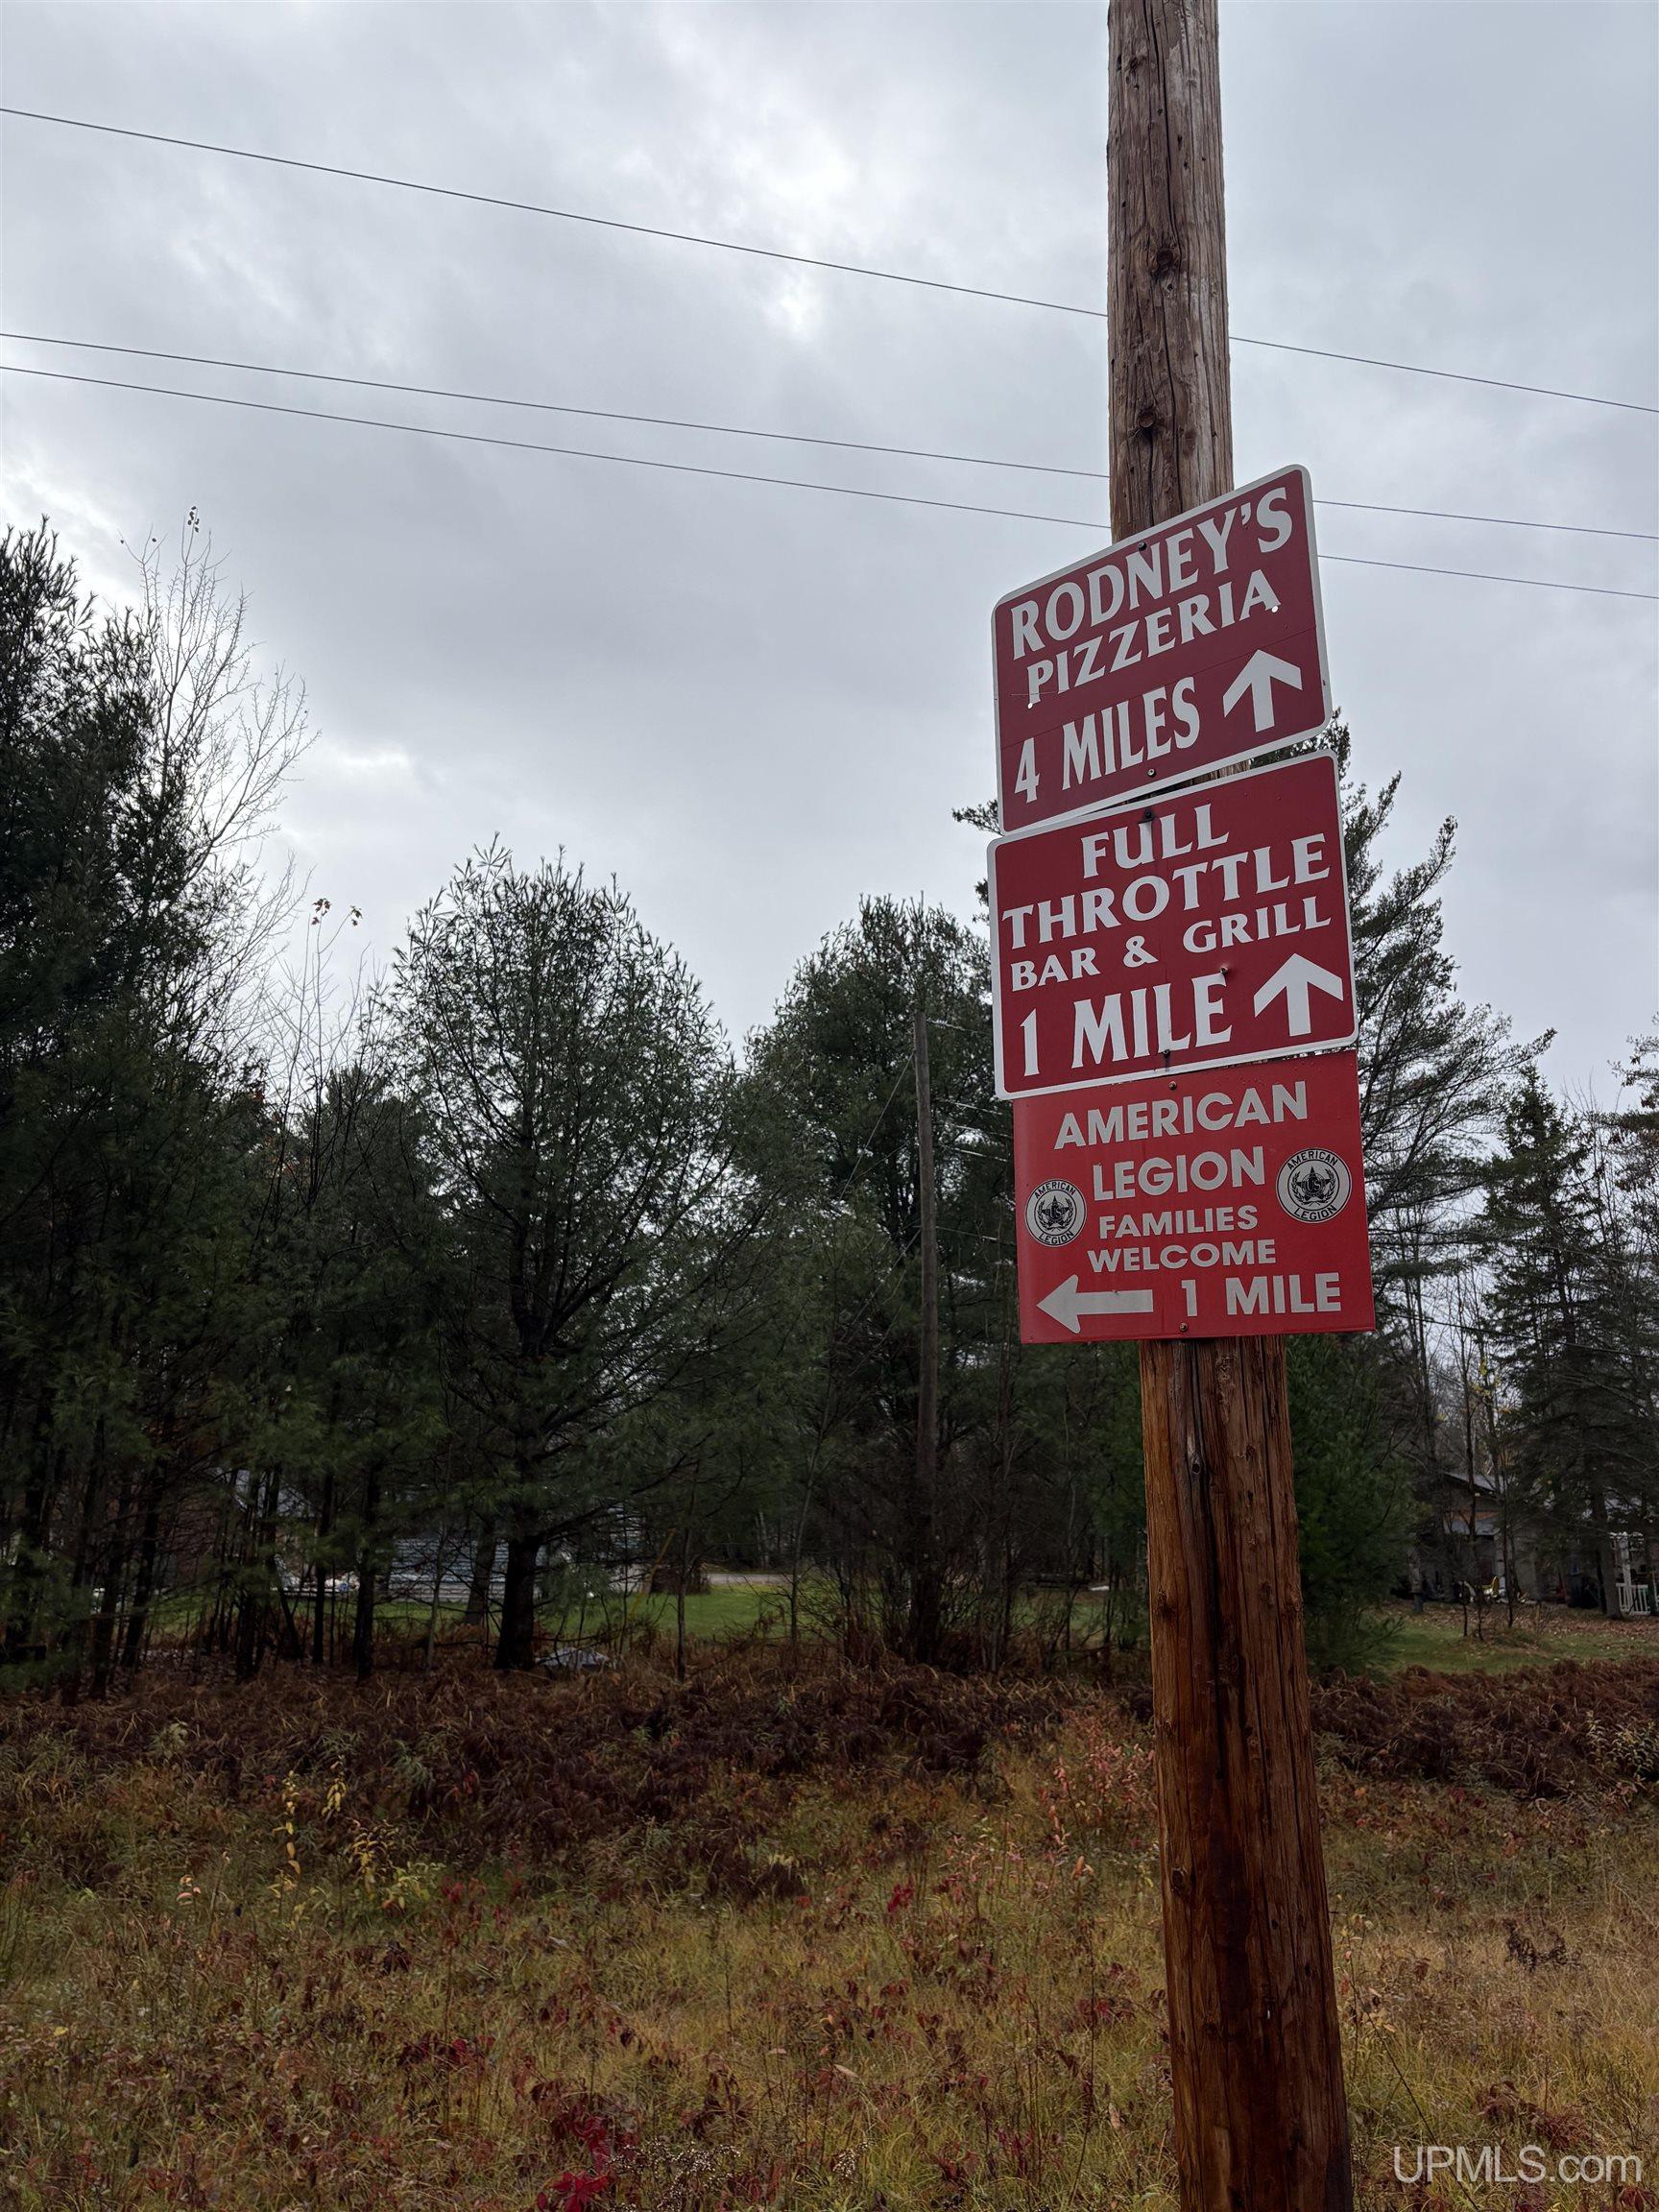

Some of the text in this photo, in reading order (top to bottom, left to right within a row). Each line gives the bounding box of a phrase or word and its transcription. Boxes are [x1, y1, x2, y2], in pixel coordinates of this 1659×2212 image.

[1011, 487, 1293, 661] RODNEY'S
[1026, 569, 1282, 706] PIZZERIA
[1014, 676, 1200, 804] 4 MILES
[1080, 803, 1230, 878] FULL
[1001, 832, 1331, 950] THROTTLE
[1010, 895, 1332, 992] BAR & GRILL
[1020, 972, 1233, 1077] 1 MILE
[1054, 1080, 1308, 1150] AMERICAN
[1034, 1181, 1076, 1199] AMERICAN
[1093, 1145, 1265, 1201] LEGION
[1287, 1150, 1338, 1170] AMERICAN
[1038, 1230, 1074, 1244] LEGION
[1099, 1205, 1258, 1239] FAMILIES
[1293, 1204, 1337, 1220] LEGION
[1087, 1238, 1277, 1273] WELCOME
[1181, 1272, 1341, 1317] 1 MILE
